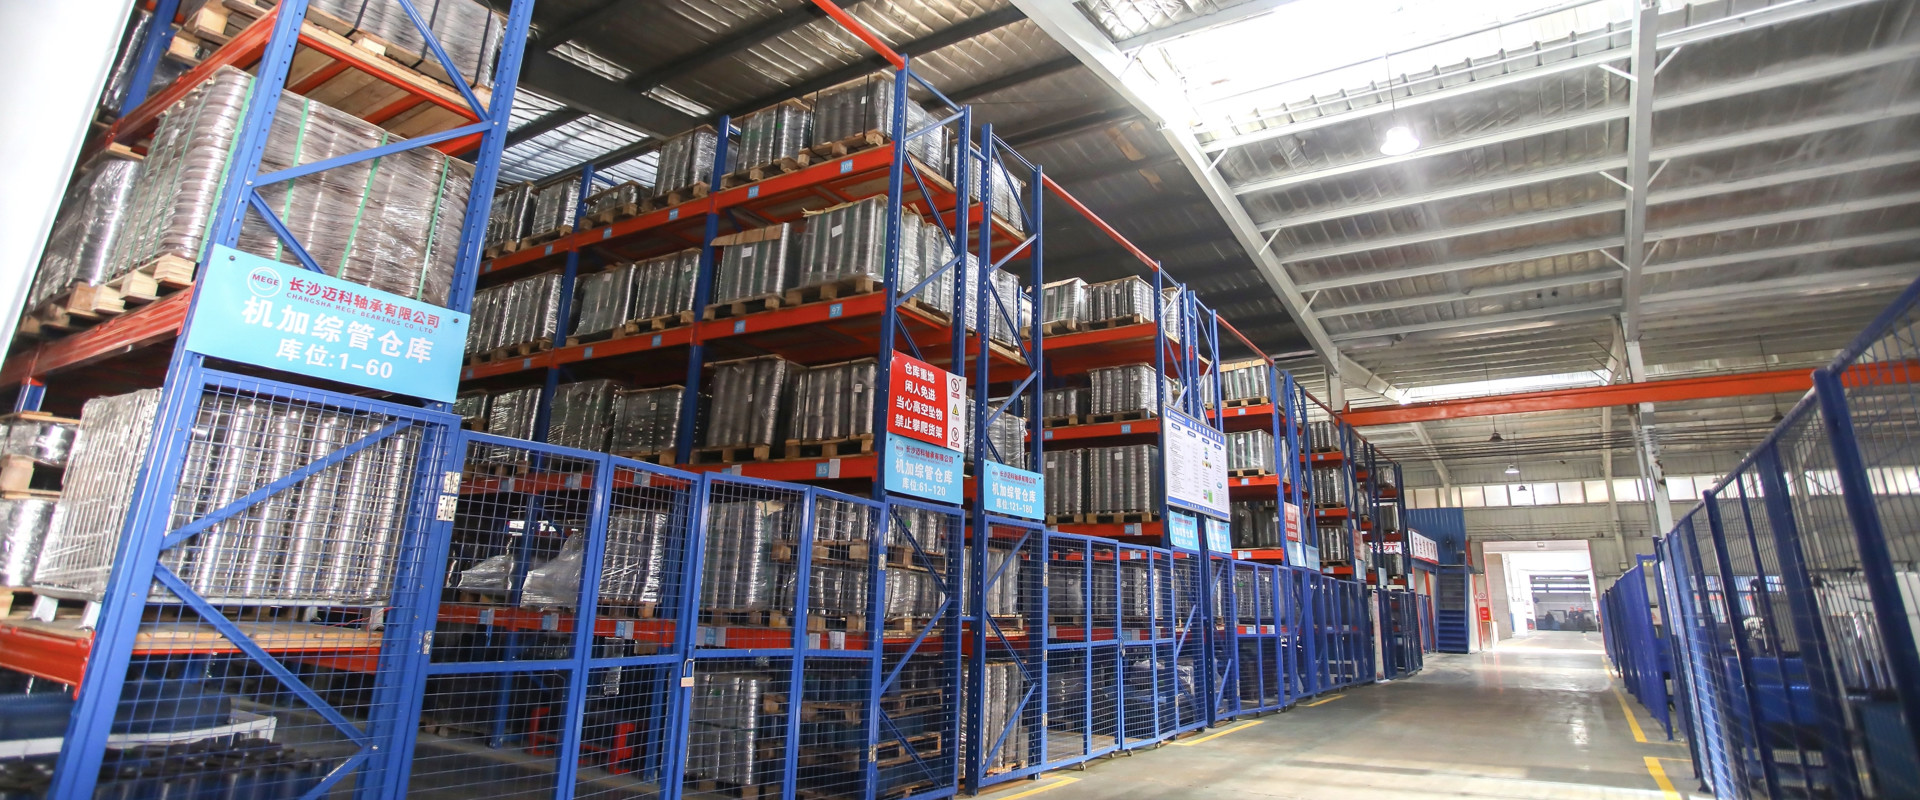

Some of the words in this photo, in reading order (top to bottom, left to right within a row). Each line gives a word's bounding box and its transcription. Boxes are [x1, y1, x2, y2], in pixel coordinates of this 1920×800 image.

[252, 273, 280, 287] MEGE
[286, 292, 332, 308] CHANGSHA
[335, 304, 356, 315] MEGE
[360, 311, 401, 326] BEARINGS
[289, 276, 440, 329] 长沙迈科轴承有限公司
[831, 306, 841, 315] 97
[241, 295, 435, 364] 机加综管仓库
[275, 337, 393, 379] 库位:1-60
[904, 362, 936, 384] 仓库重地
[904, 379, 937, 402] 闲人免进
[896, 395, 943, 422] 当心高空坠物
[894, 413, 943, 439] 禁止攀爬货架
[895, 457, 953, 485] 机加综管仓库
[992, 481, 1036, 503] 机加综管仓库
